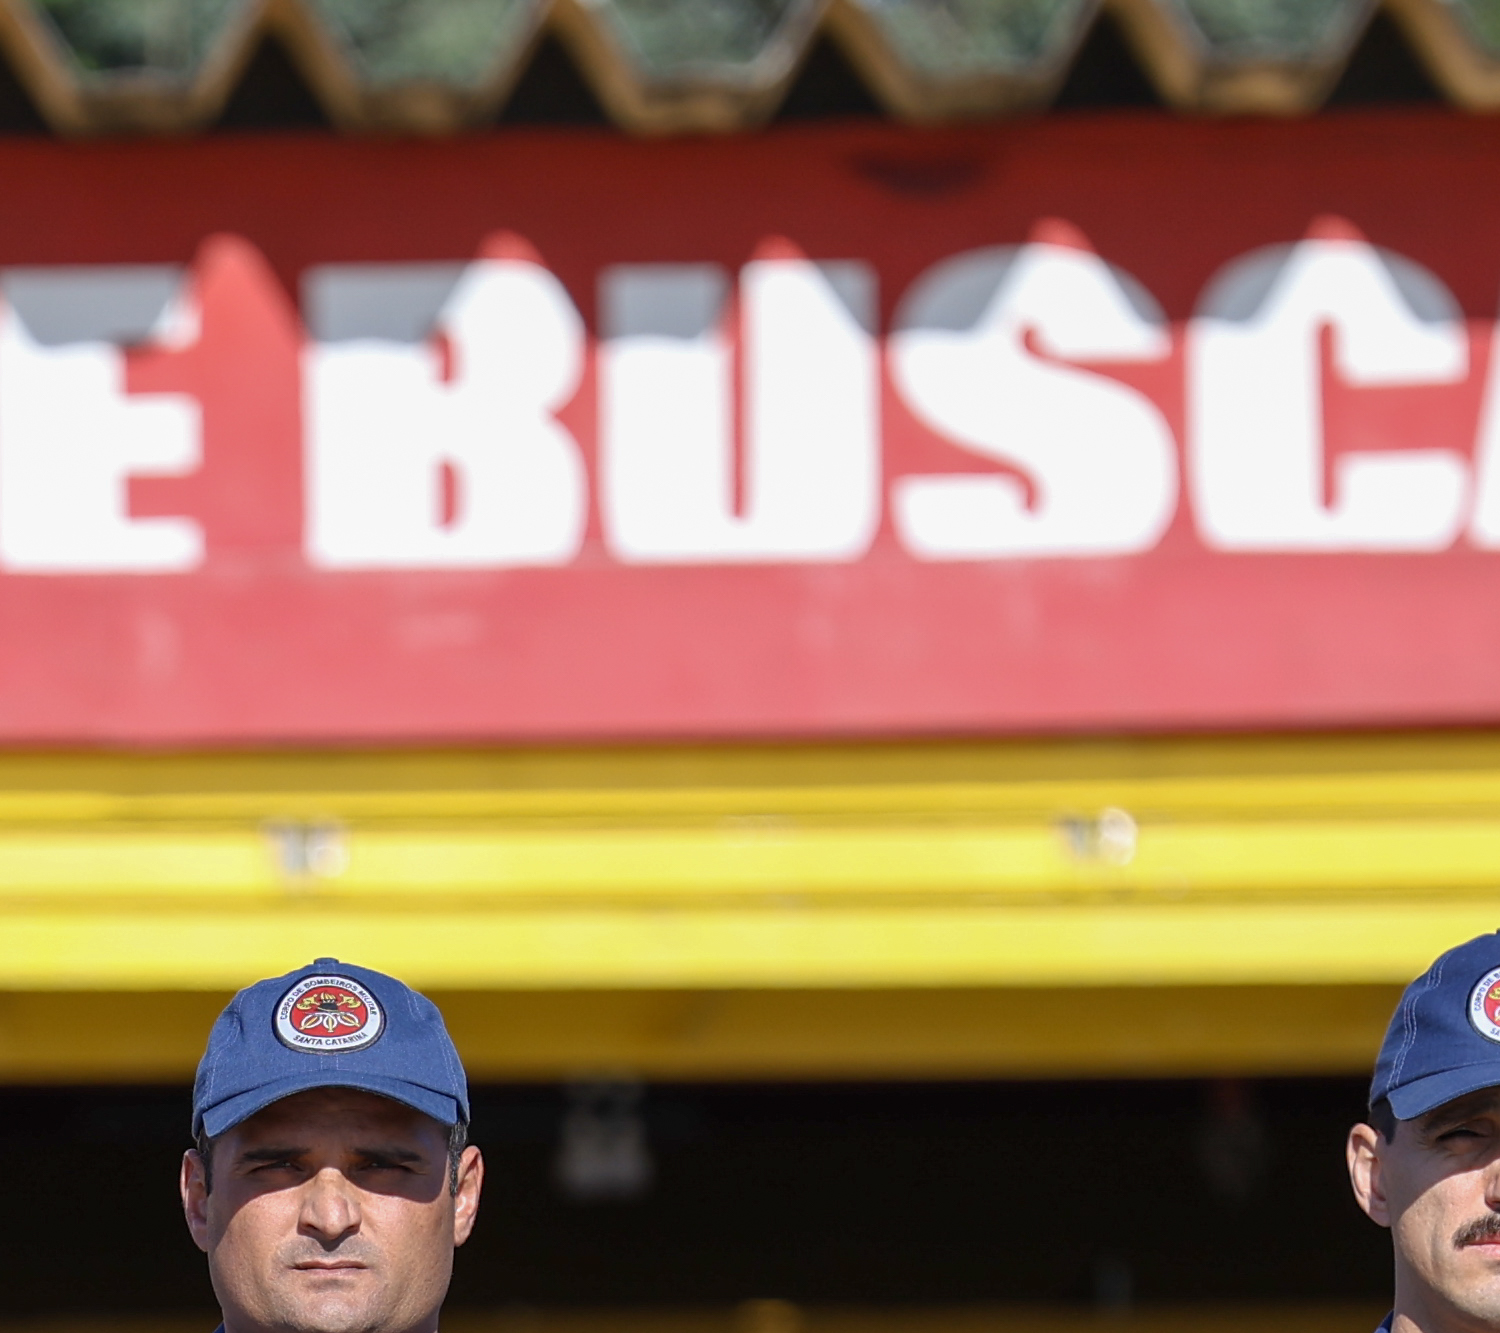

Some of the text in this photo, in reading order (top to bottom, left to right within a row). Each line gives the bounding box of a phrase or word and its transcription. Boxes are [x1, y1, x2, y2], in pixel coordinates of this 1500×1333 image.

[280, 978, 378, 1020] CORPO DE BOMBEIROS MILITAR
[292, 1031, 368, 1046] SANTA CATARINA
